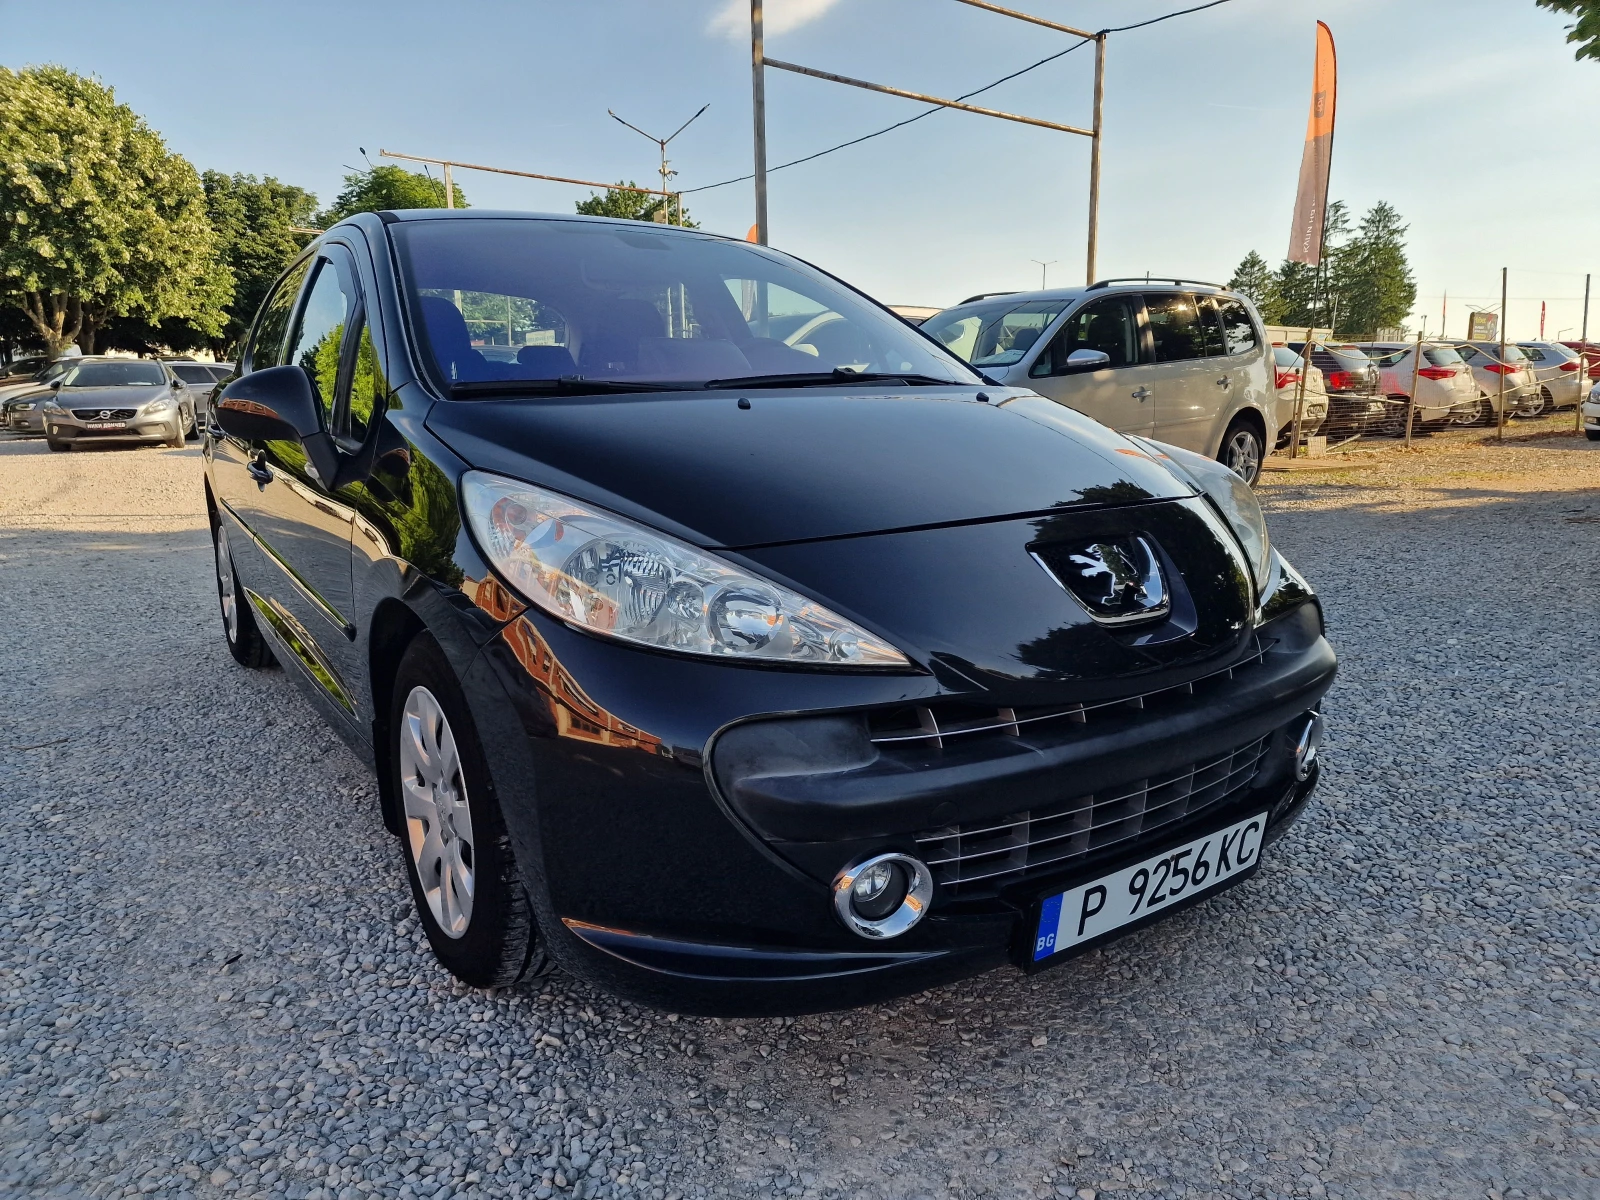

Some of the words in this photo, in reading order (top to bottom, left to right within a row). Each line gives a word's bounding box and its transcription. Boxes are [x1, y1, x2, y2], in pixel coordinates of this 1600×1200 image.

[1077, 884, 1107, 937] P
[1128, 840, 1210, 916] 9256
[1036, 933, 1055, 952] BG
